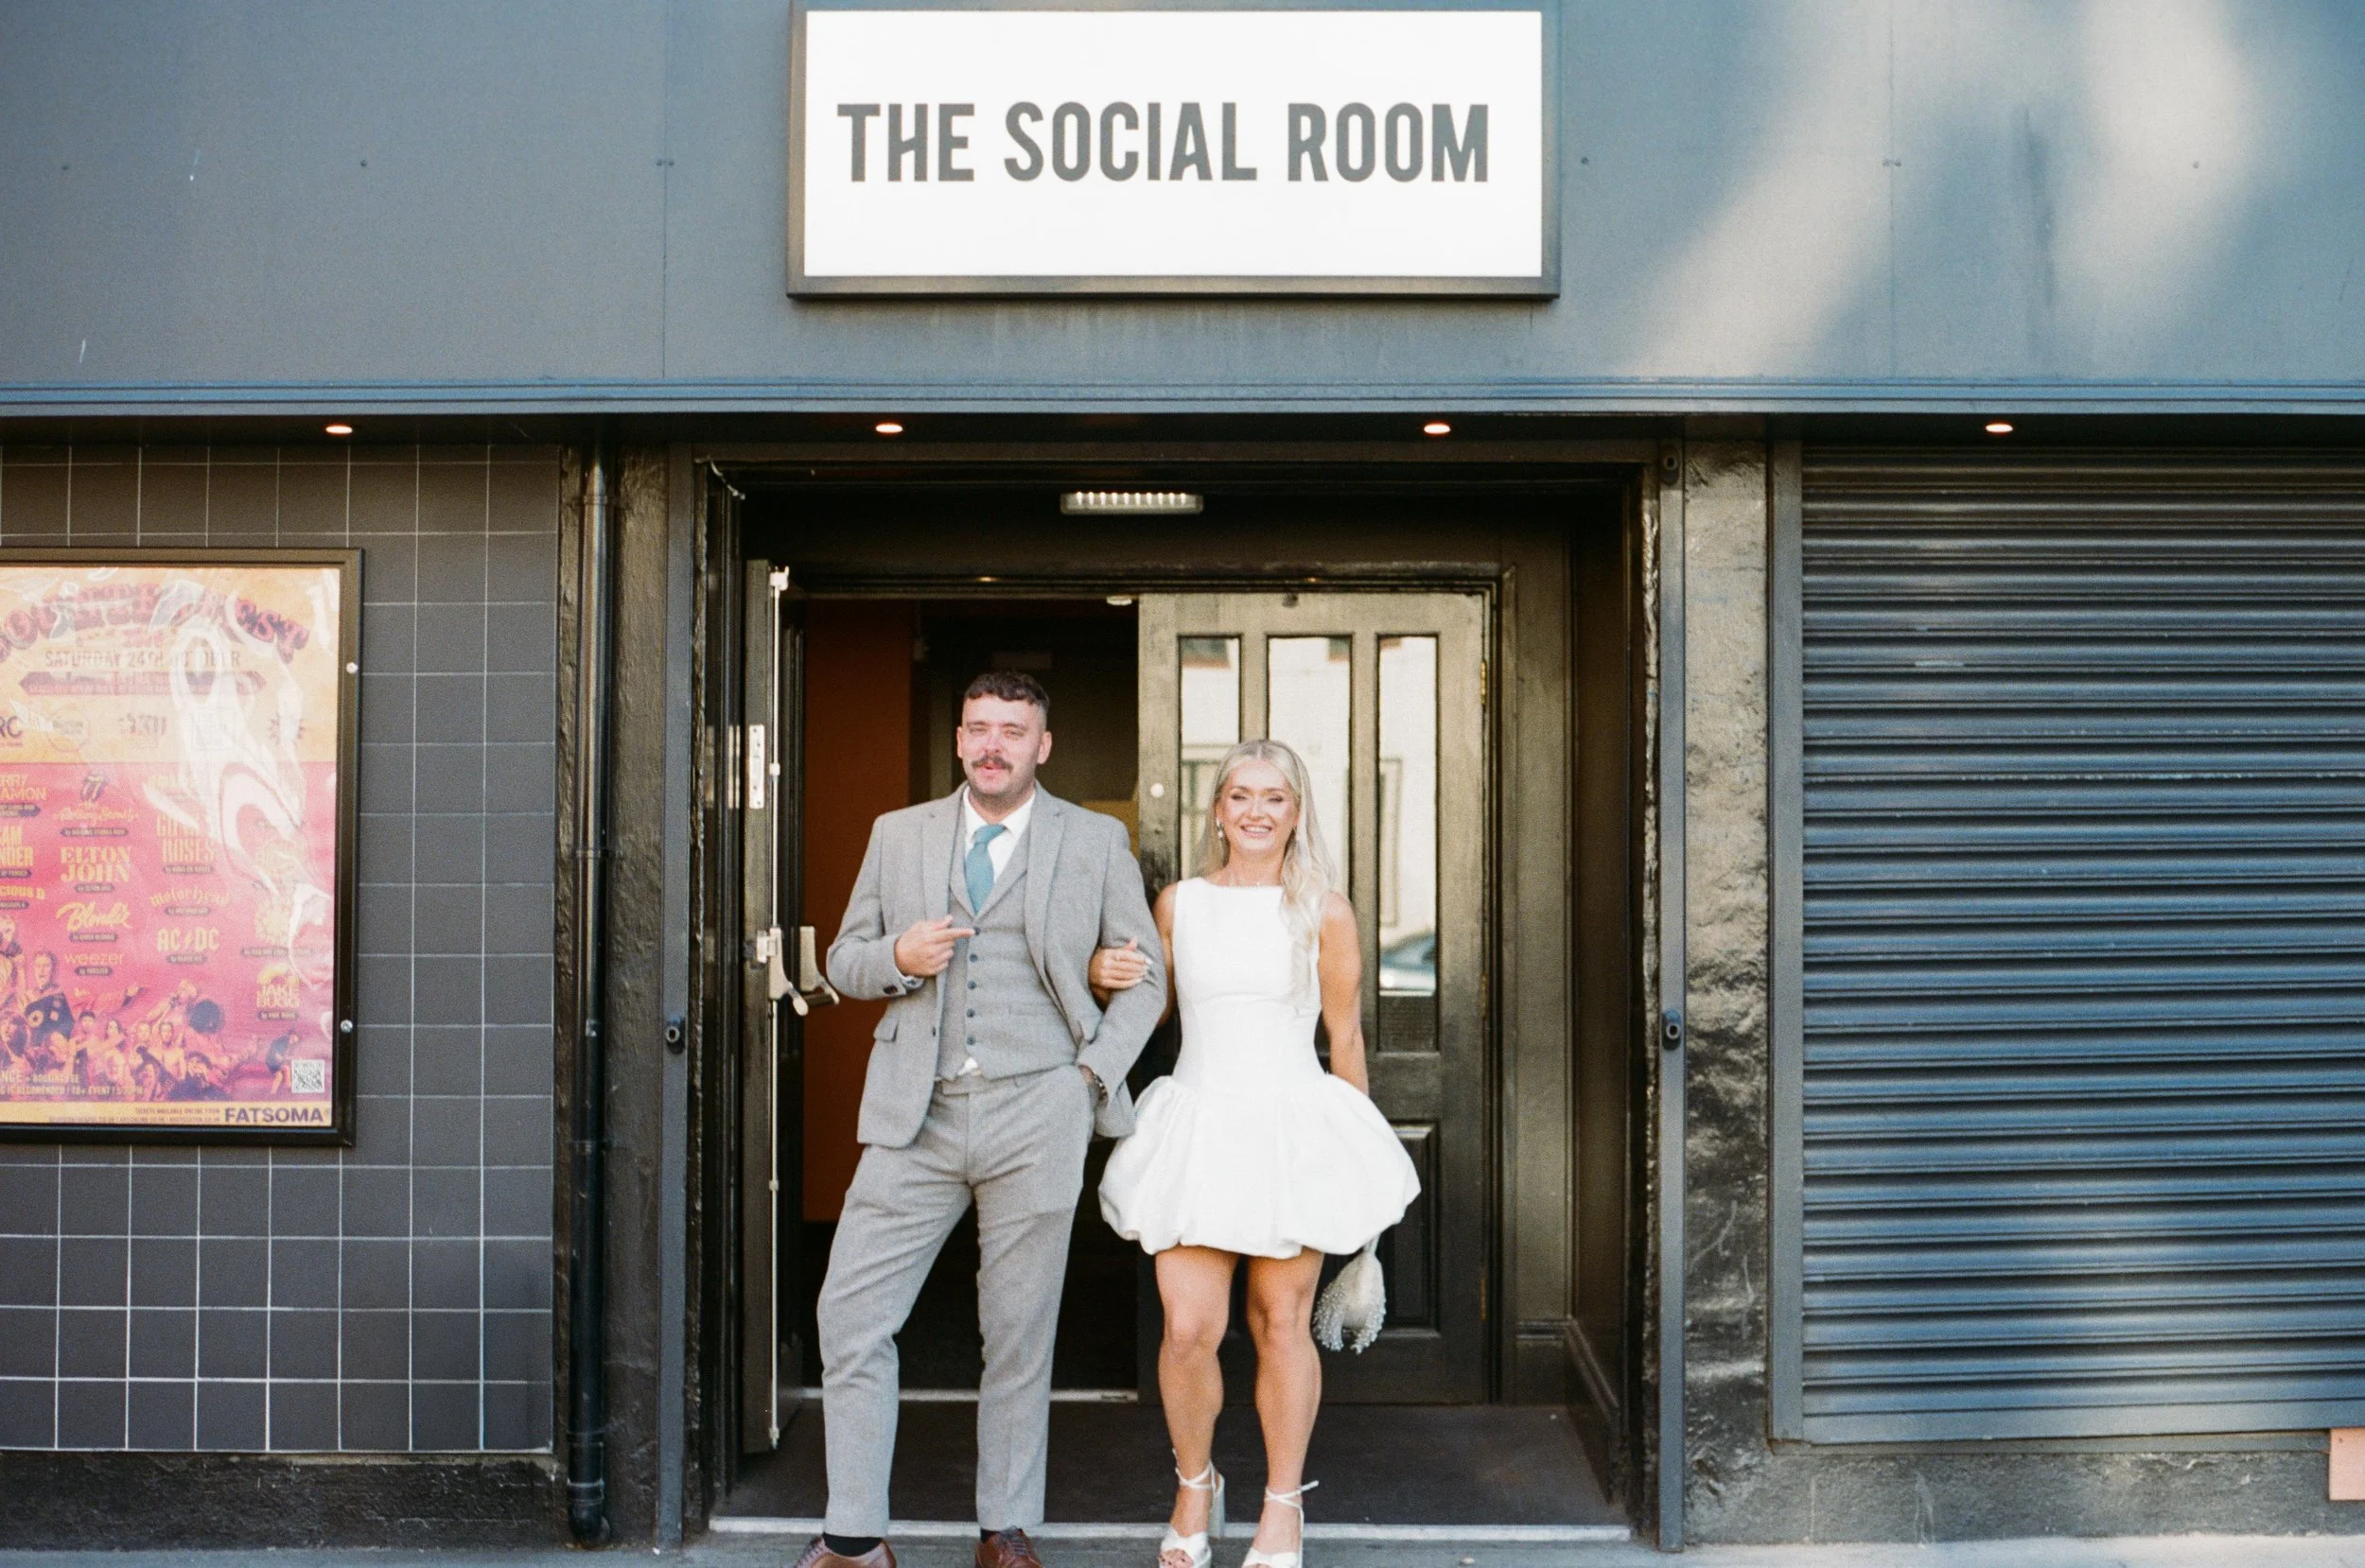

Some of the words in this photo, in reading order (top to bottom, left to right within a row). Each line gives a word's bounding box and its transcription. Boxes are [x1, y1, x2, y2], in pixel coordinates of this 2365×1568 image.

[837, 103, 974, 182] THE
[1004, 101, 1257, 182] SOCIAL
[1288, 102, 1488, 183] ROOM
[61, 845, 131, 864] ELTON
[60, 862, 130, 883] JOHN
[64, 952, 125, 965] weezer
[225, 1107, 324, 1123] FATSOMA
